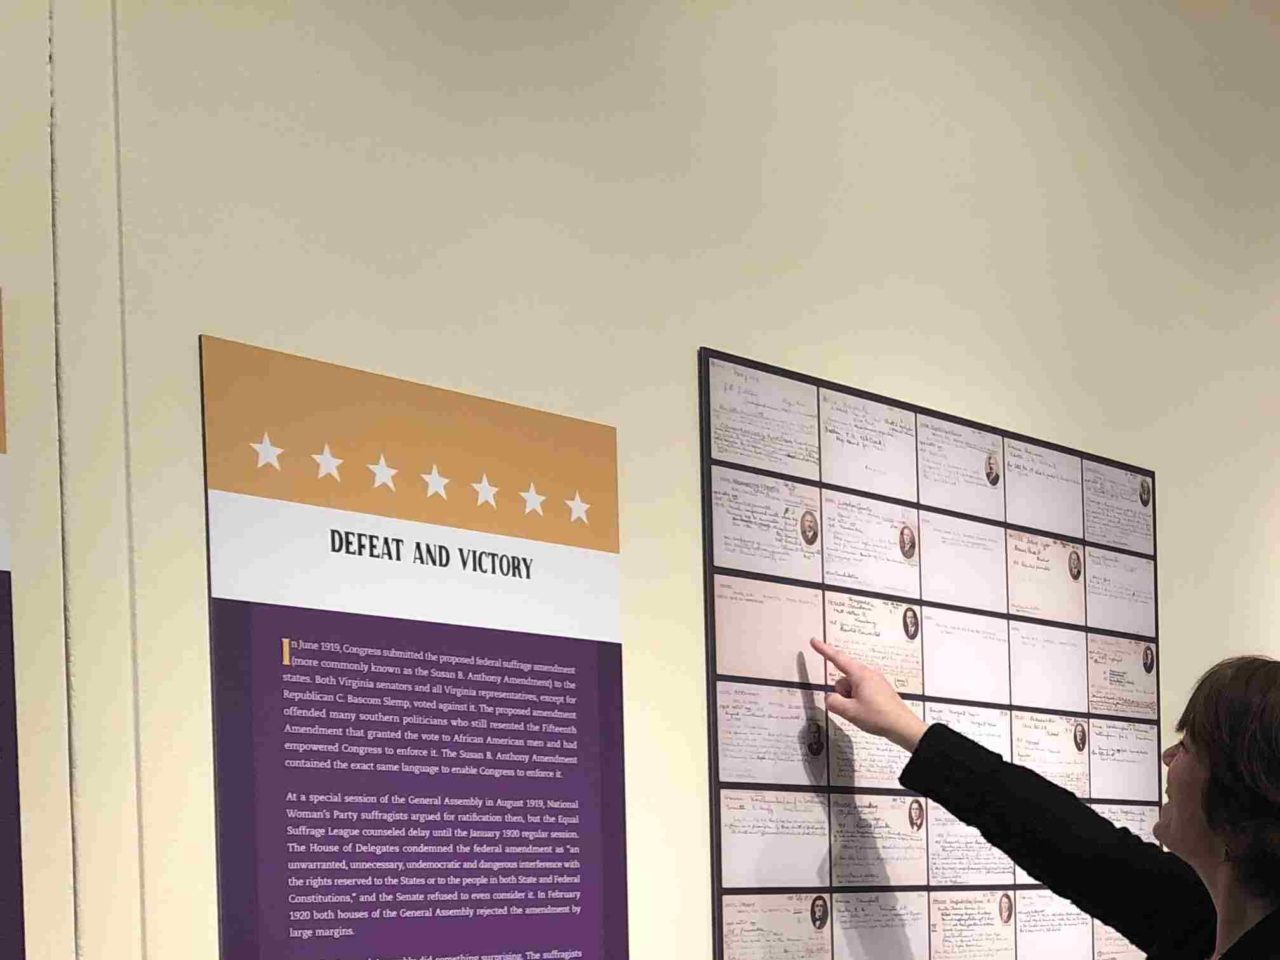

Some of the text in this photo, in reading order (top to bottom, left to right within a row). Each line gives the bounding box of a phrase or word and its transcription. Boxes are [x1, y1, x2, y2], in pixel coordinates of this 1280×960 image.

[330, 529, 534, 580] DEFEAT AND VICTORY
[297, 639, 320, 650] June
[319, 641, 343, 654] 1919,
[342, 643, 382, 657] Congress
[381, 647, 424, 660] submitted
[424, 651, 439, 662] the
[438, 654, 475, 666] proposed
[475, 656, 502, 668] federal
[501, 659, 533, 673] suffrage
[532, 663, 576, 674] amendment
[291, 655, 320, 667] (more
[319, 660, 369, 674] commonly
[370, 662, 401, 675] known
[402, 667, 413, 675] as
[414, 666, 429, 677] the
[429, 667, 456, 679] Susan
[466, 671, 502, 685] Anthony
[502, 674, 553, 689] Amendment)
[553, 680, 563, 689] to
[563, 679, 577, 690] the
[282, 705, 578, 734] offended many southern politicians who still resented the Fifteenth
[283, 723, 578, 749] Amendment that granted the vote to African American men and had
[283, 742, 339, 753] empowered
[341, 743, 383, 756] Congress
[384, 746, 395, 755] to
[395, 746, 429, 757] enforce
[429, 747, 439, 757] it.
[440, 748, 458, 758] The
[458, 749, 485, 760] Susan
[495, 751, 530, 764] Anthony
[531, 753, 578, 764] Amendment
[285, 791, 579, 810] At a special session of the General Assembly in August 1919, National
[286, 825, 580, 841] Suffrage League counseled delay until the January 1920 regular session.
[288, 903, 582, 920] 1920 both houses of the General Assembly rejected the amendment by
[289, 926, 355, 940] large margins.
[524, 950, 541, 960] The
[541, 949, 583, 960] suffragists
